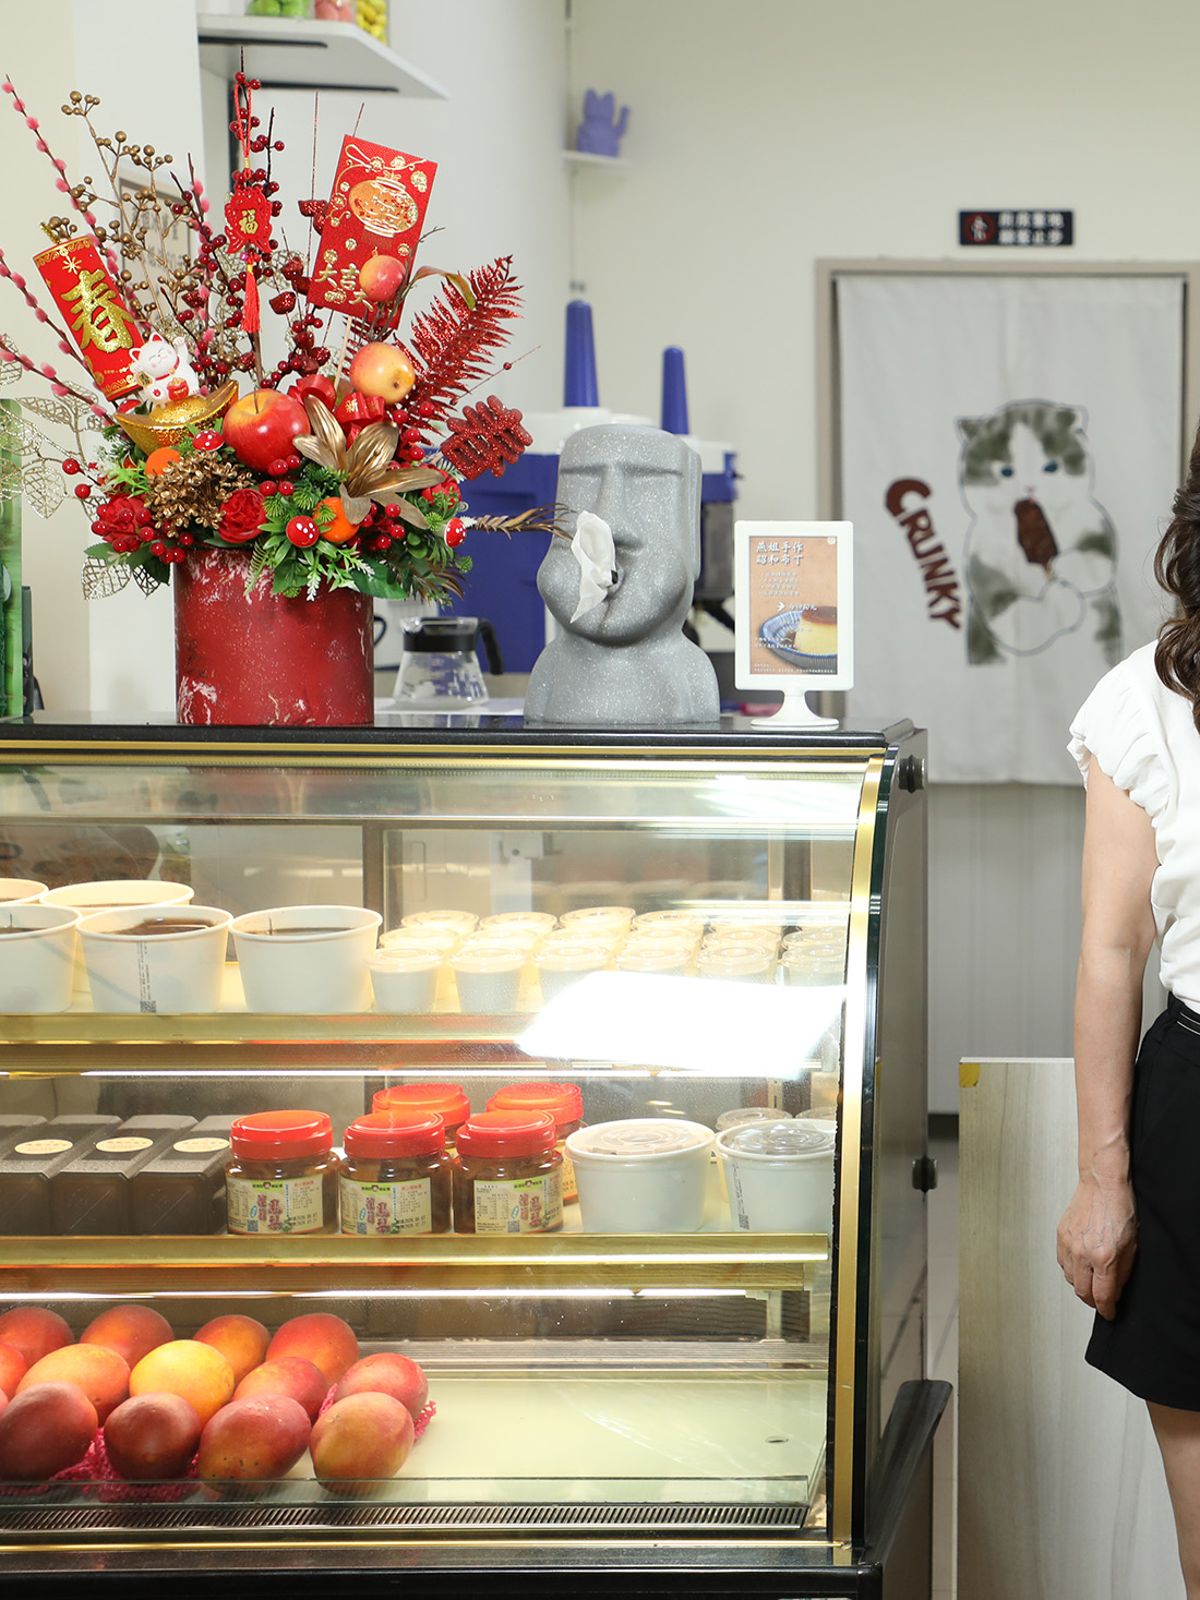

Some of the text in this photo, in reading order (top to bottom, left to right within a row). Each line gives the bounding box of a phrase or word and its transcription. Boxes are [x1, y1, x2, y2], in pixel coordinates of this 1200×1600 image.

[238, 209, 259, 235] 福
[60, 269, 135, 353] 春
[885, 479, 961, 630] CRUNKY
